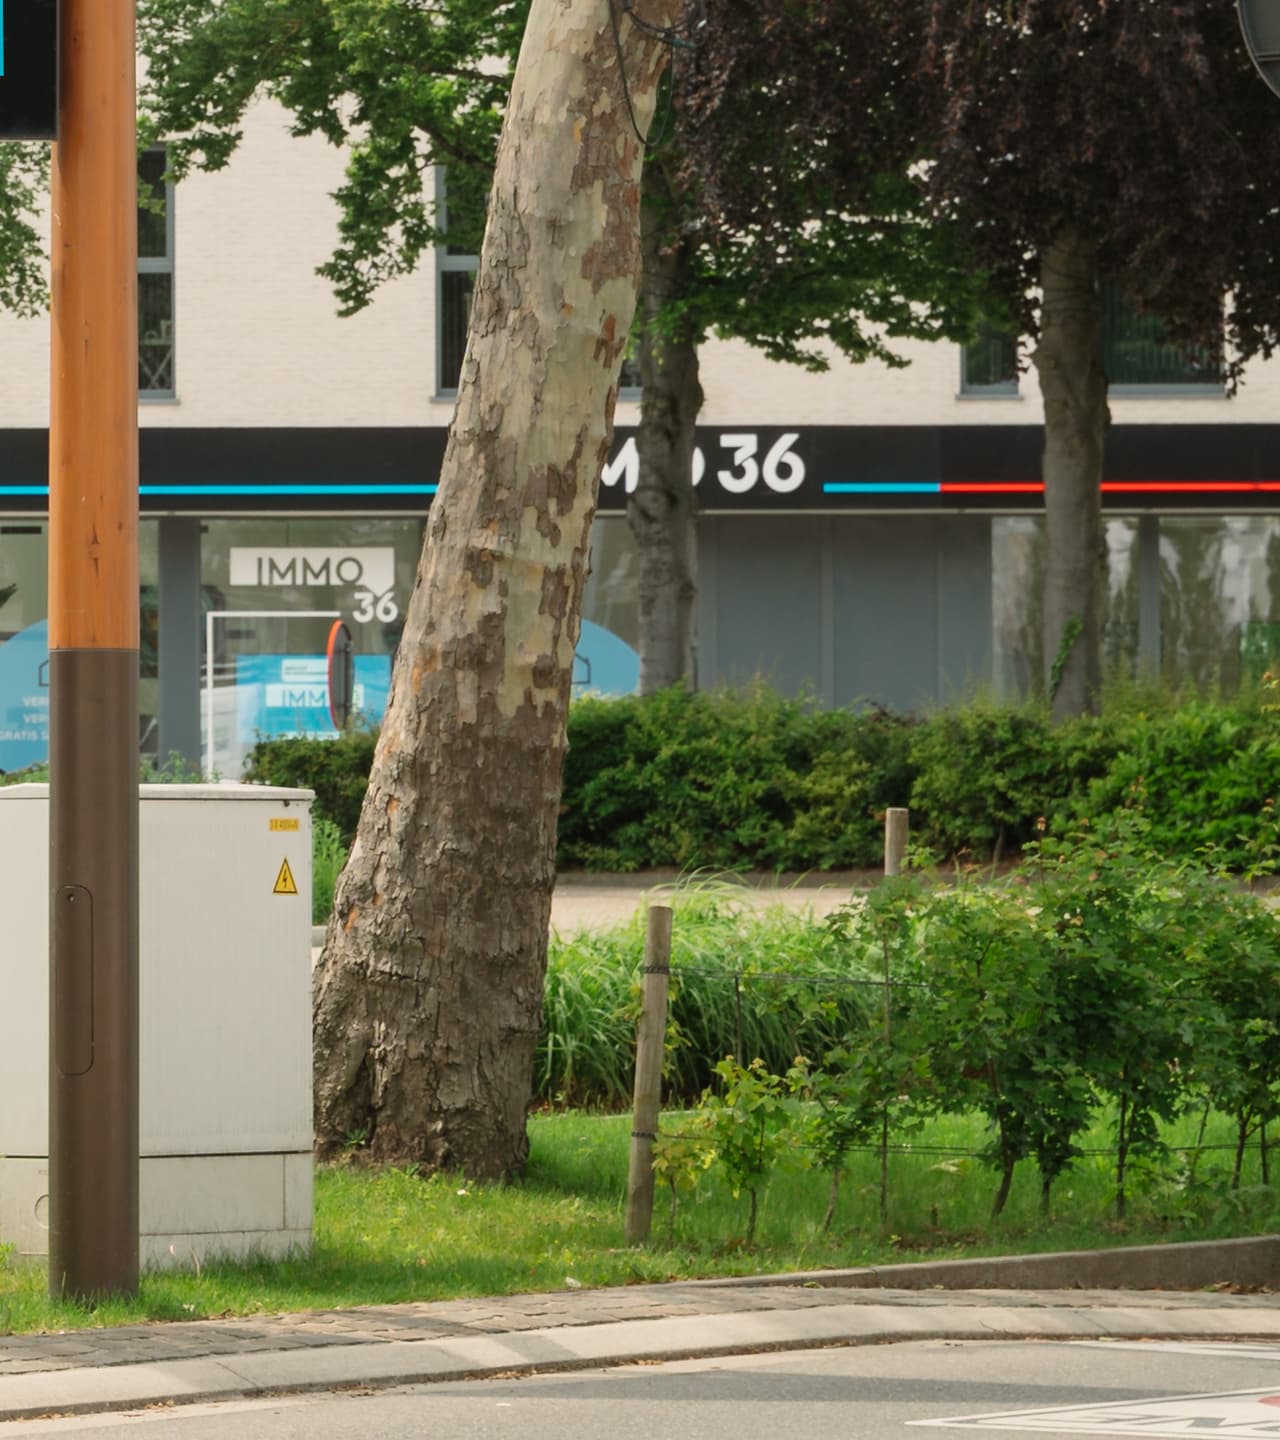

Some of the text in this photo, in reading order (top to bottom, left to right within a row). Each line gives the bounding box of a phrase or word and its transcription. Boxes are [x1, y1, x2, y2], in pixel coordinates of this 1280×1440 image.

[717, 433, 806, 494] 36
[257, 556, 364, 586] IMMO
[351, 591, 399, 624] 36
